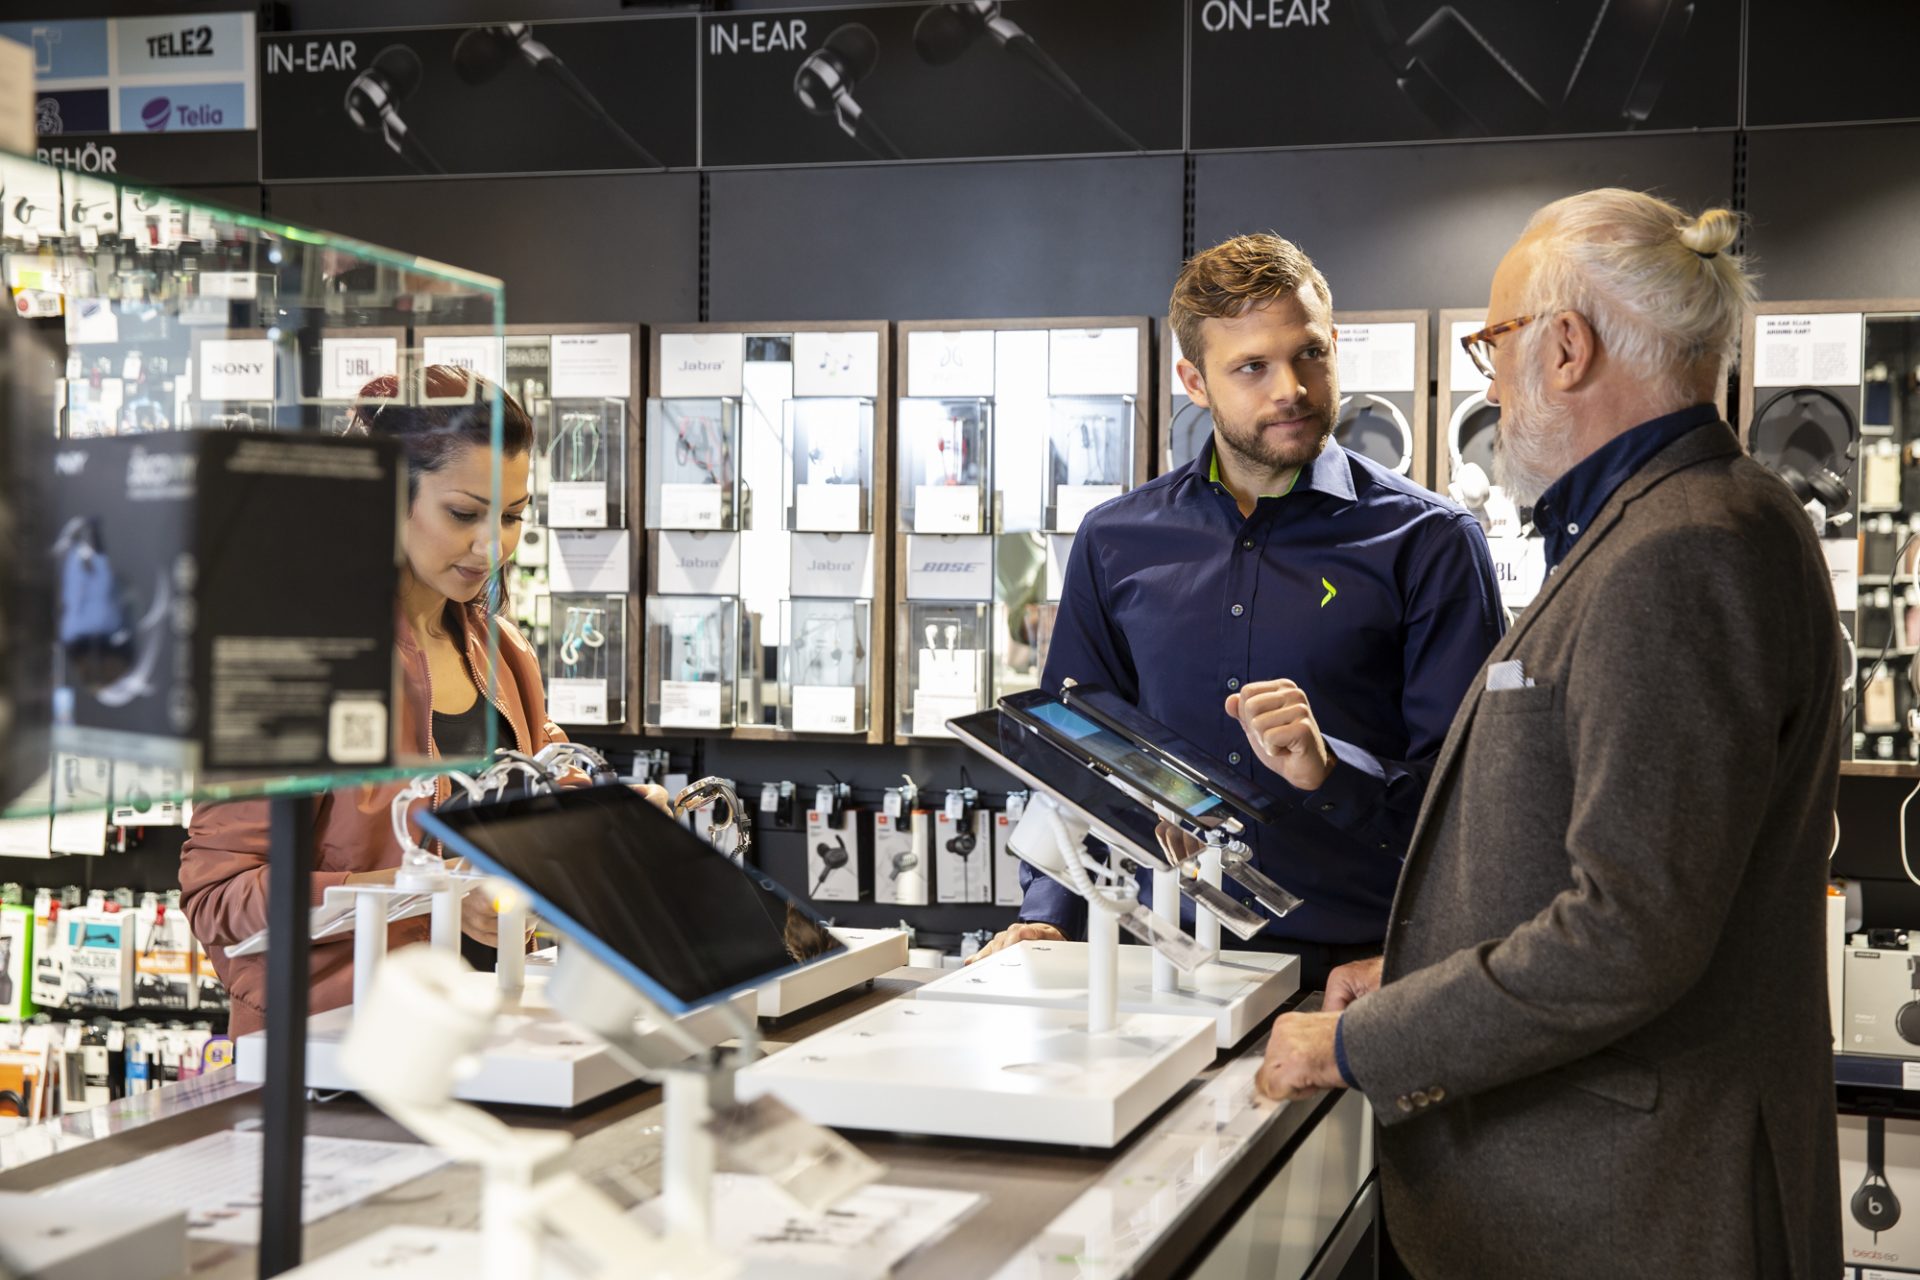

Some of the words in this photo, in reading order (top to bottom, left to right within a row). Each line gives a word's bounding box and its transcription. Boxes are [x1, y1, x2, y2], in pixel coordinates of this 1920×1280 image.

[1201, 0, 1331, 31] ON-EAR
[146, 25, 214, 59] TELE2
[710, 19, 808, 55] IN-EAR
[267, 40, 357, 74] IN-EAR
[177, 104, 223, 127] Telia
[211, 363, 265, 376] SONY
[346, 358, 374, 377] JBL
[679, 360, 723, 372] Jabra
[676, 557, 721, 570] Jabra
[807, 560, 854, 572] Jabra
[921, 562, 978, 573] BOSE
[1495, 562, 1517, 581] BL
